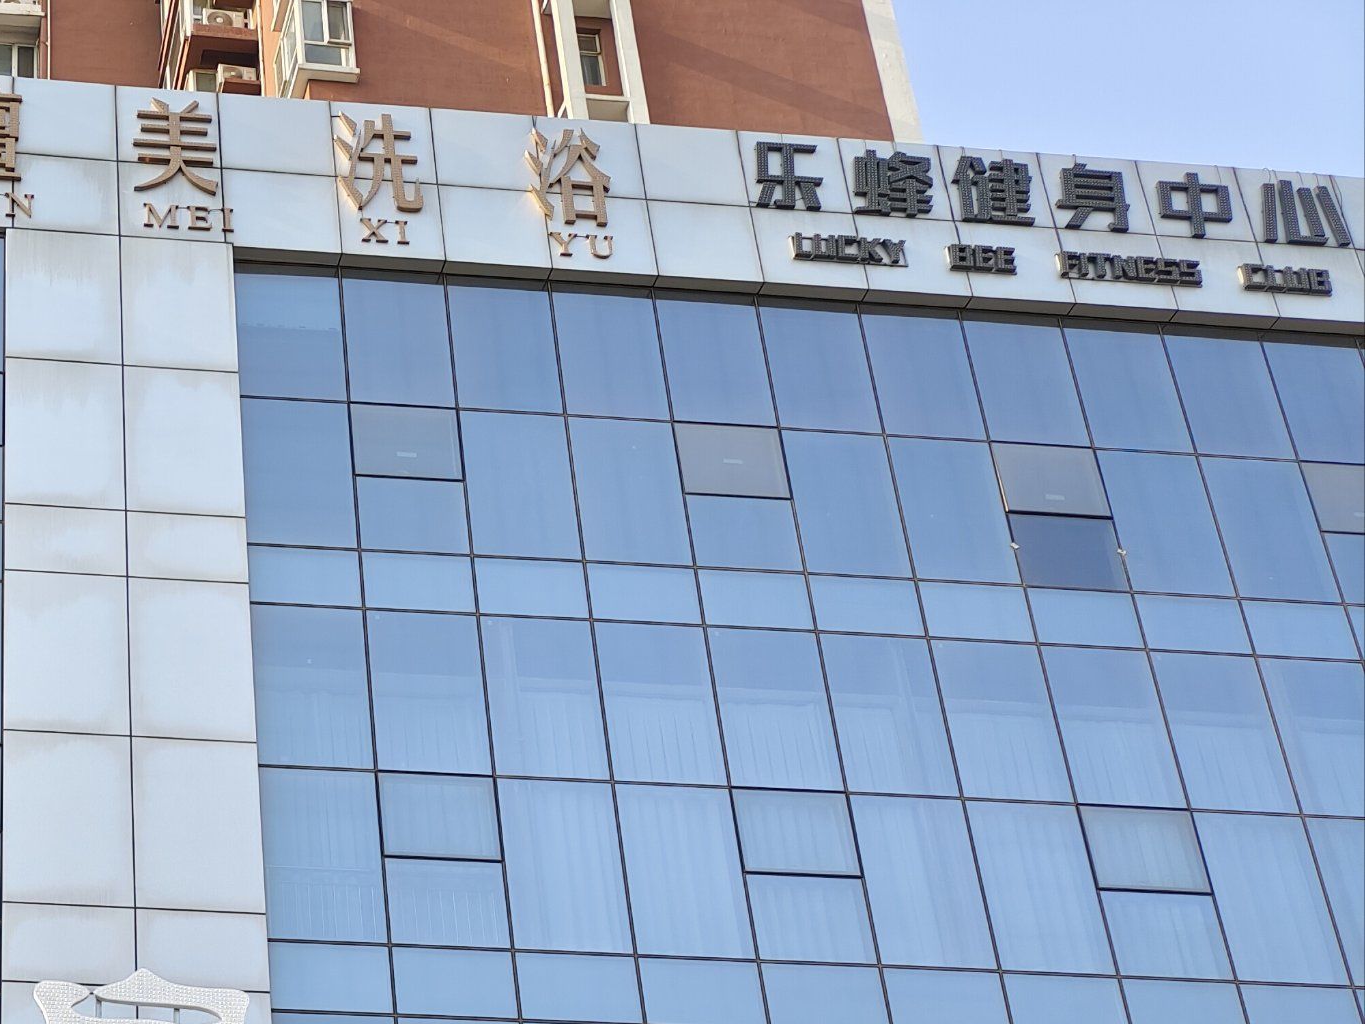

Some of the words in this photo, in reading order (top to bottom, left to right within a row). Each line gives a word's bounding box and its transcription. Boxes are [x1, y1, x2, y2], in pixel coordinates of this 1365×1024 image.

[755, 142, 1351, 247] 乐蜂健身中心
[143, 202, 233, 233] MEI
[360, 218, 410, 245] XI
[549, 231, 614, 259] YU
[792, 232, 907, 266] LUCKY
[947, 243, 1016, 274] BEE
[1056, 251, 1202, 287] FITNESS
[1239, 263, 1332, 296] CLUB
